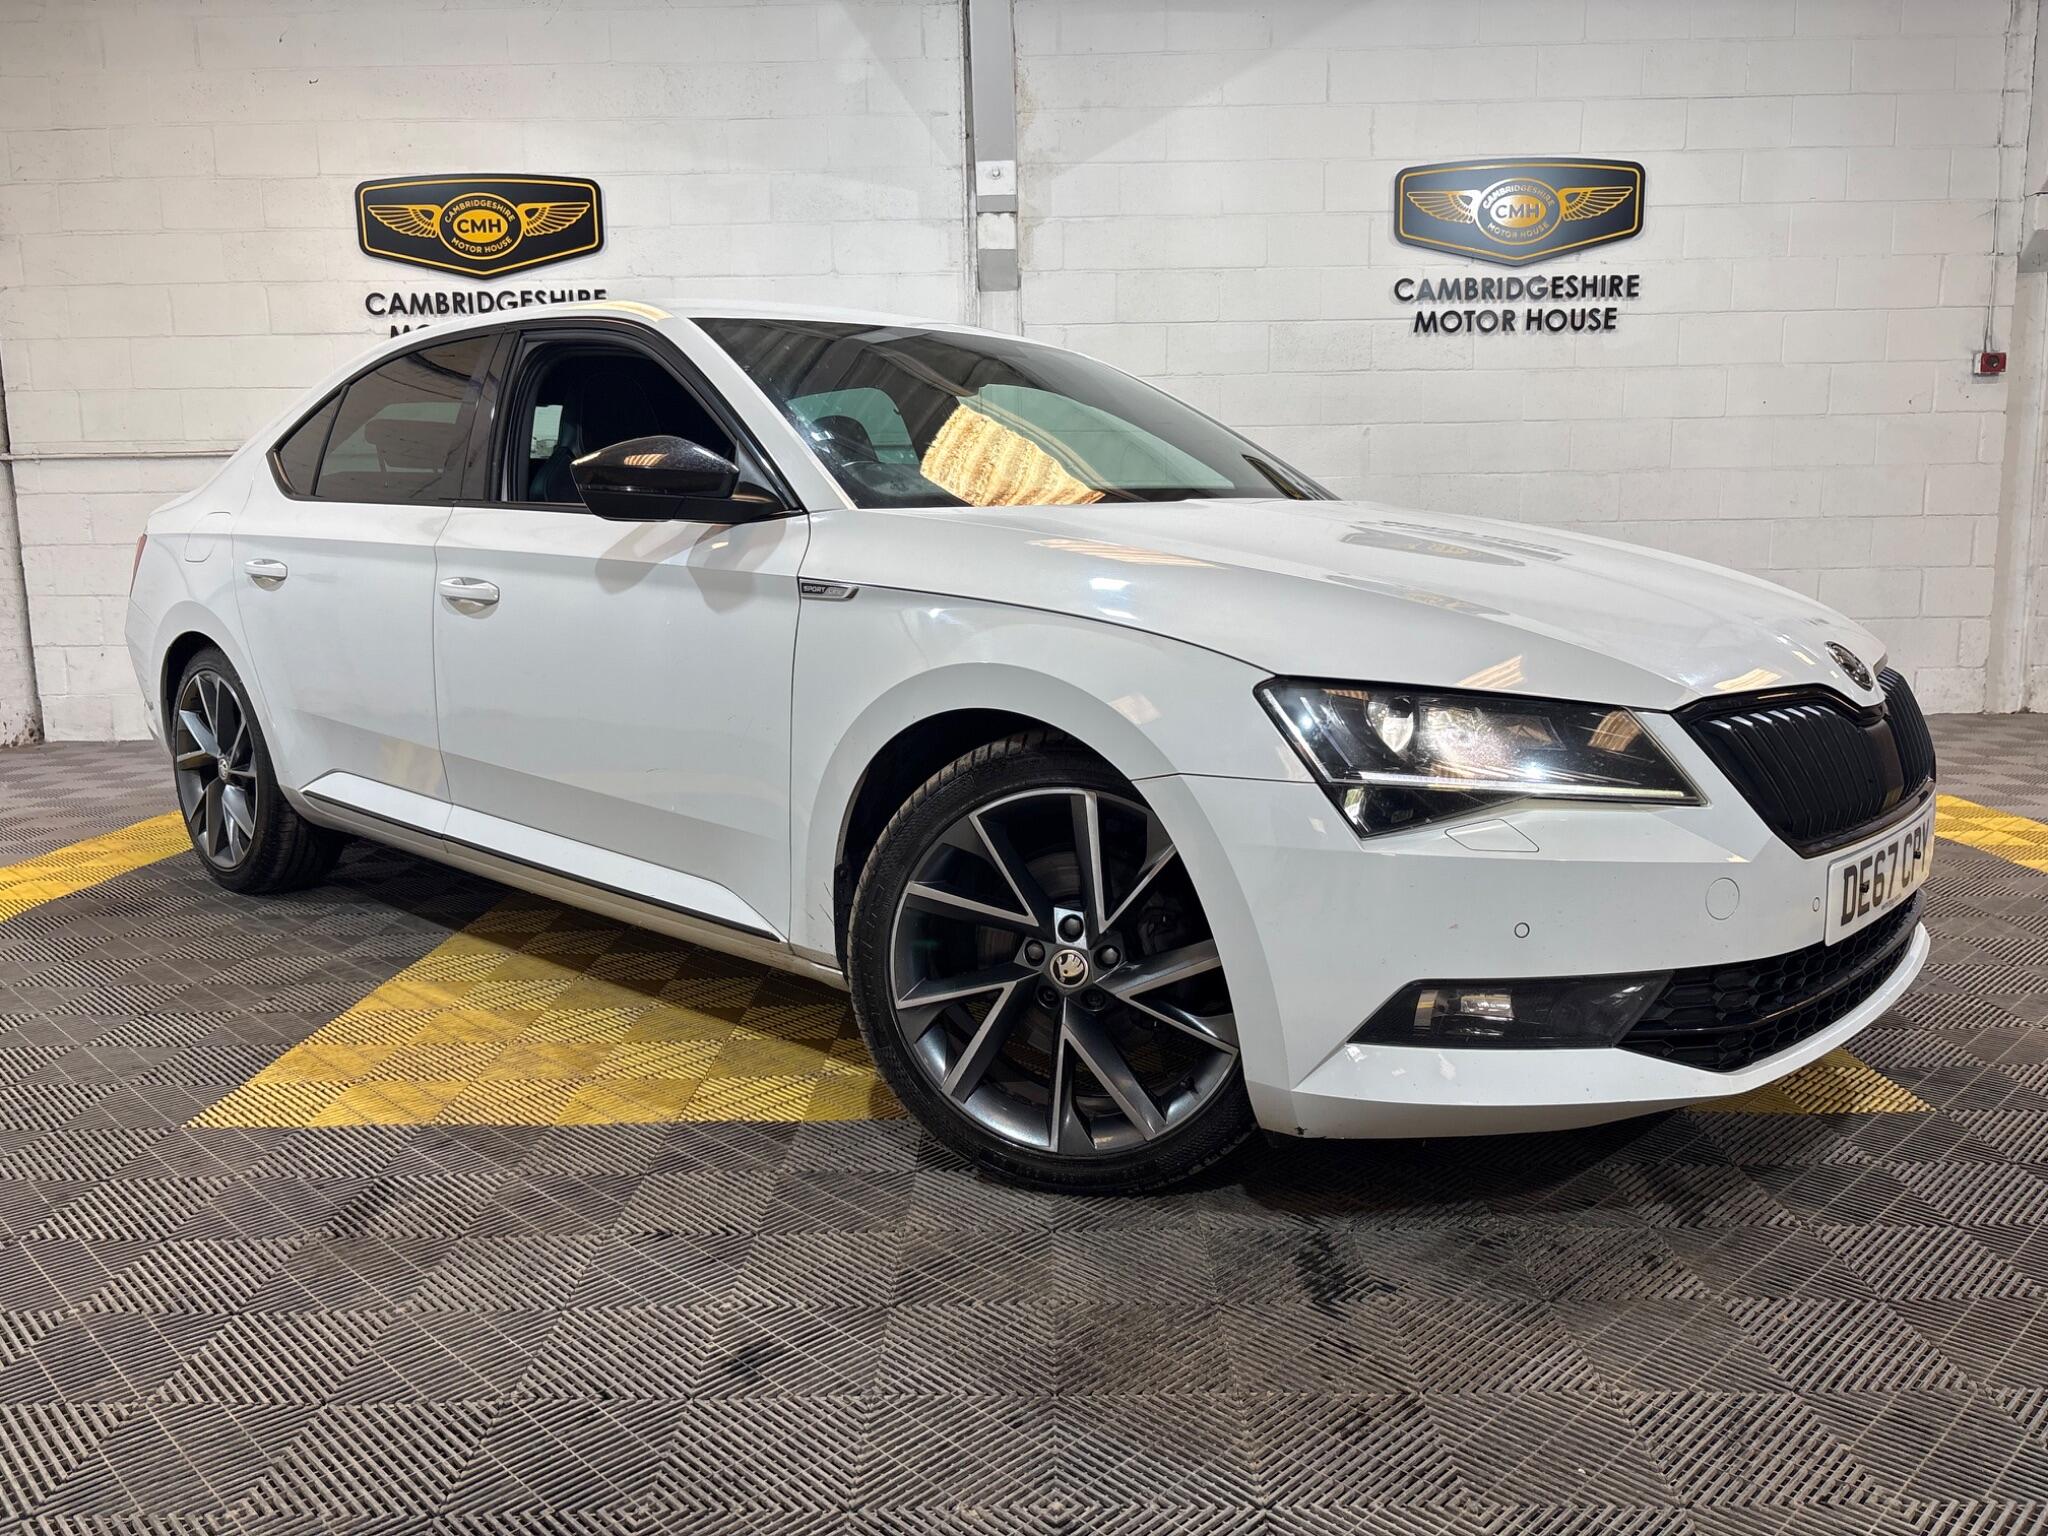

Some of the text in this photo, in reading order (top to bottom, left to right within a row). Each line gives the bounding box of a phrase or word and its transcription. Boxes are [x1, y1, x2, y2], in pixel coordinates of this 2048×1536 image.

[1483, 185, 1555, 209] CAMBRIDGESHIRE
[444, 200, 516, 223] CAMBRIDGESHIRE
[1495, 204, 1540, 219] CMH
[456, 218, 502, 234] CMH
[1487, 222, 1518, 238] MOTOR
[451, 236, 513, 253] MOTOR HOUSE
[1394, 274, 1640, 301] CAMBRIDGESHIRE
[1413, 307, 1618, 333] MOTOR HOUSE
[1841, 841, 1899, 926] DE67
